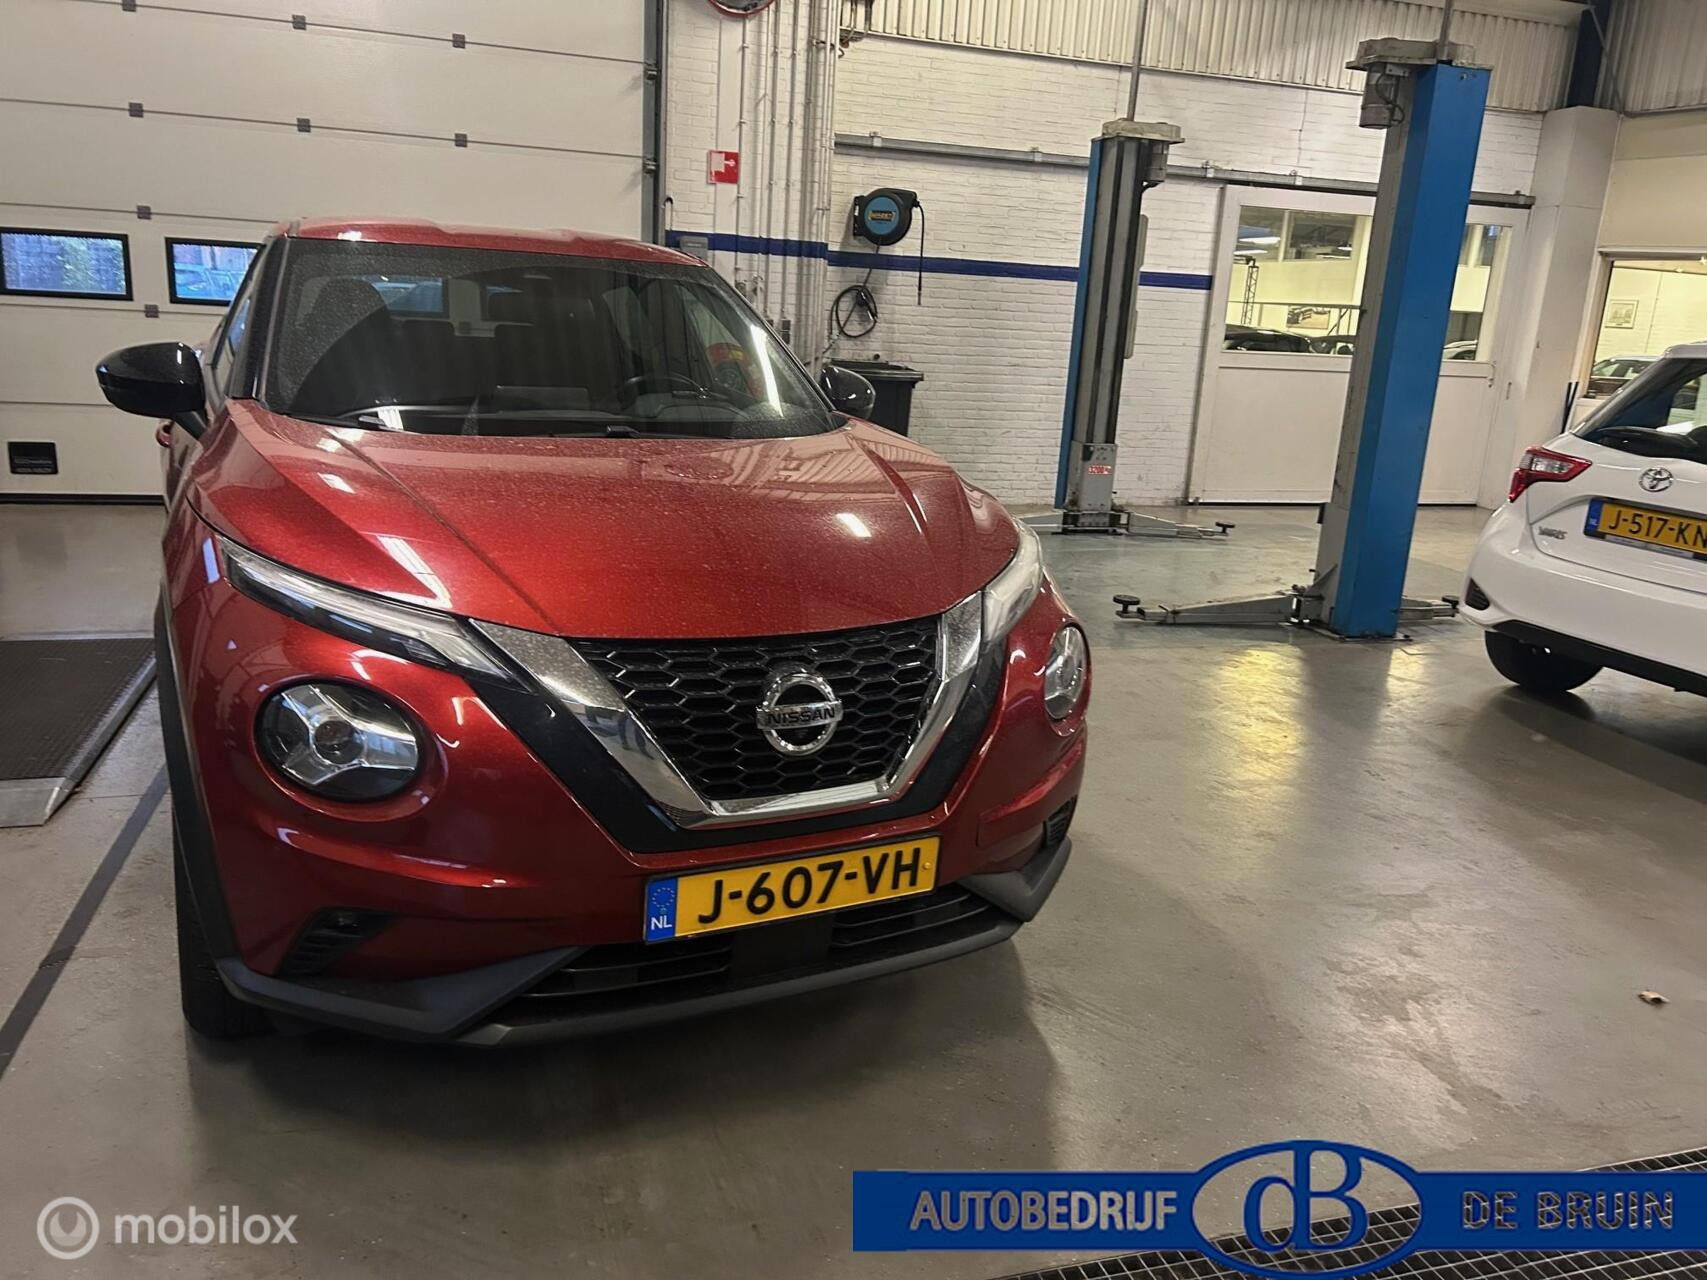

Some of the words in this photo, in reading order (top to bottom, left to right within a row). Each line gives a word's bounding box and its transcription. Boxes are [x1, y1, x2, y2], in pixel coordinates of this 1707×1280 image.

[1608, 510, 1707, 548] J-517-KN
[767, 707, 835, 724] NISSAN
[697, 847, 921, 924] J-607-VH
[650, 915, 672, 931] NL
